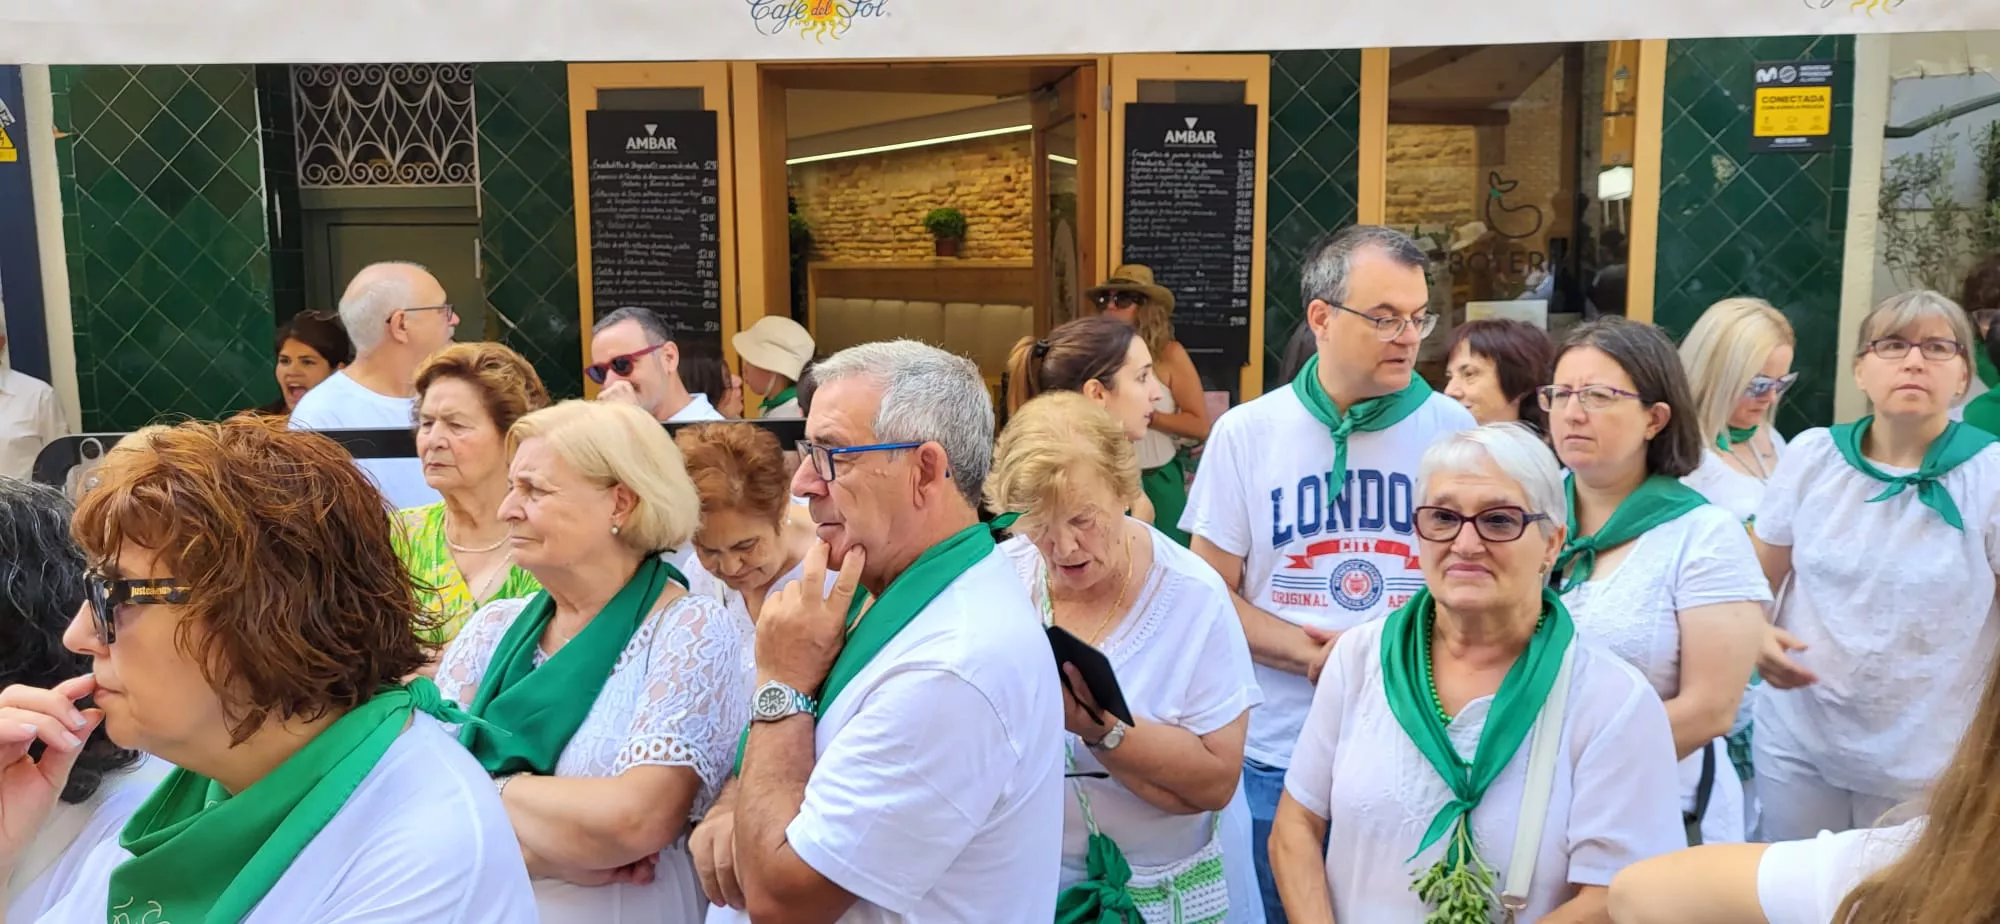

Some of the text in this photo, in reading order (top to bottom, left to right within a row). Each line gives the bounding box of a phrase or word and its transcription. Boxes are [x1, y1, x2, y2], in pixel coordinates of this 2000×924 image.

[811, 3, 832, 16] del
[1761, 95, 1825, 104] CONECTADA
[625, 136, 678, 150] AMBAR
[1163, 129, 1216, 144] AMBAR
[1339, 537, 1376, 552] CITY
[1272, 590, 1329, 608] ORIGINAL
